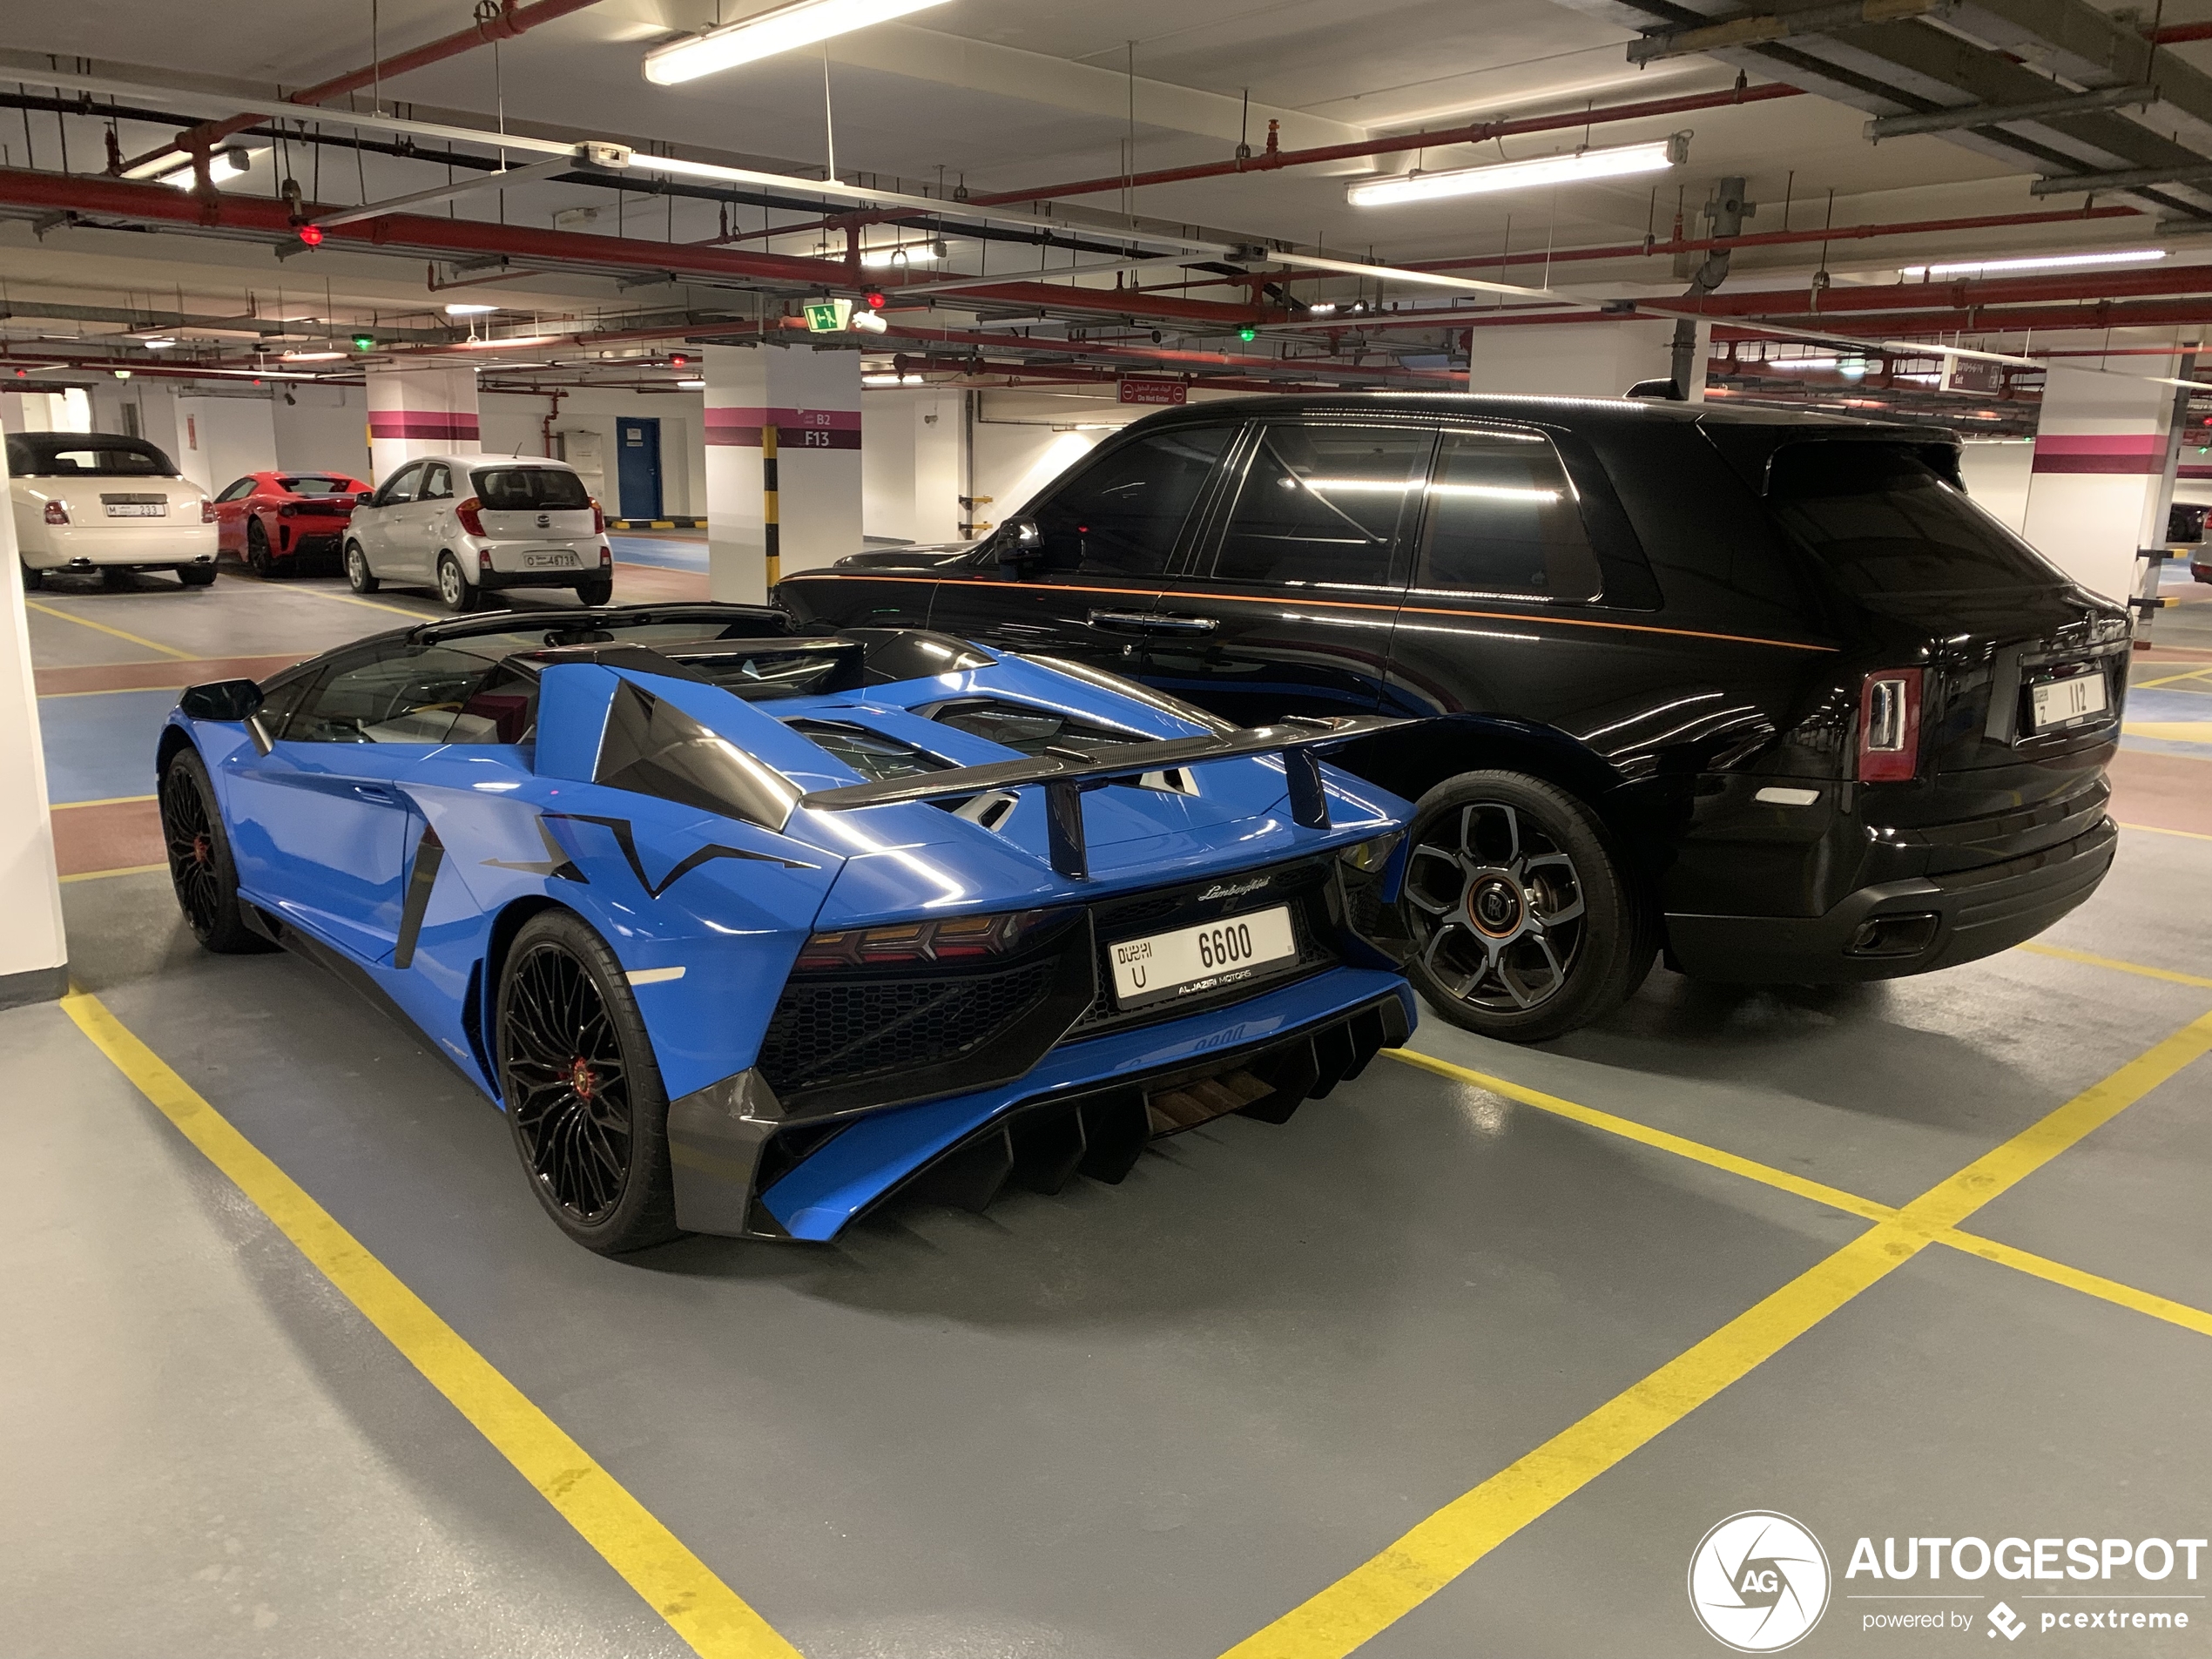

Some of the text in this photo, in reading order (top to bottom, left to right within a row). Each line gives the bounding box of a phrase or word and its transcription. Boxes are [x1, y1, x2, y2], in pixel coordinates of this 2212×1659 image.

[816, 414, 831, 425] B2
[805, 430, 830, 447] F13
[139, 505, 158, 516] 233
[2070, 682, 2087, 713] 112
[1197, 876, 1271, 901] Lamborghini
[1198, 923, 1252, 968] 6600
[1131, 965, 1147, 988] U
[1219, 969, 1251, 984] MOTORS
